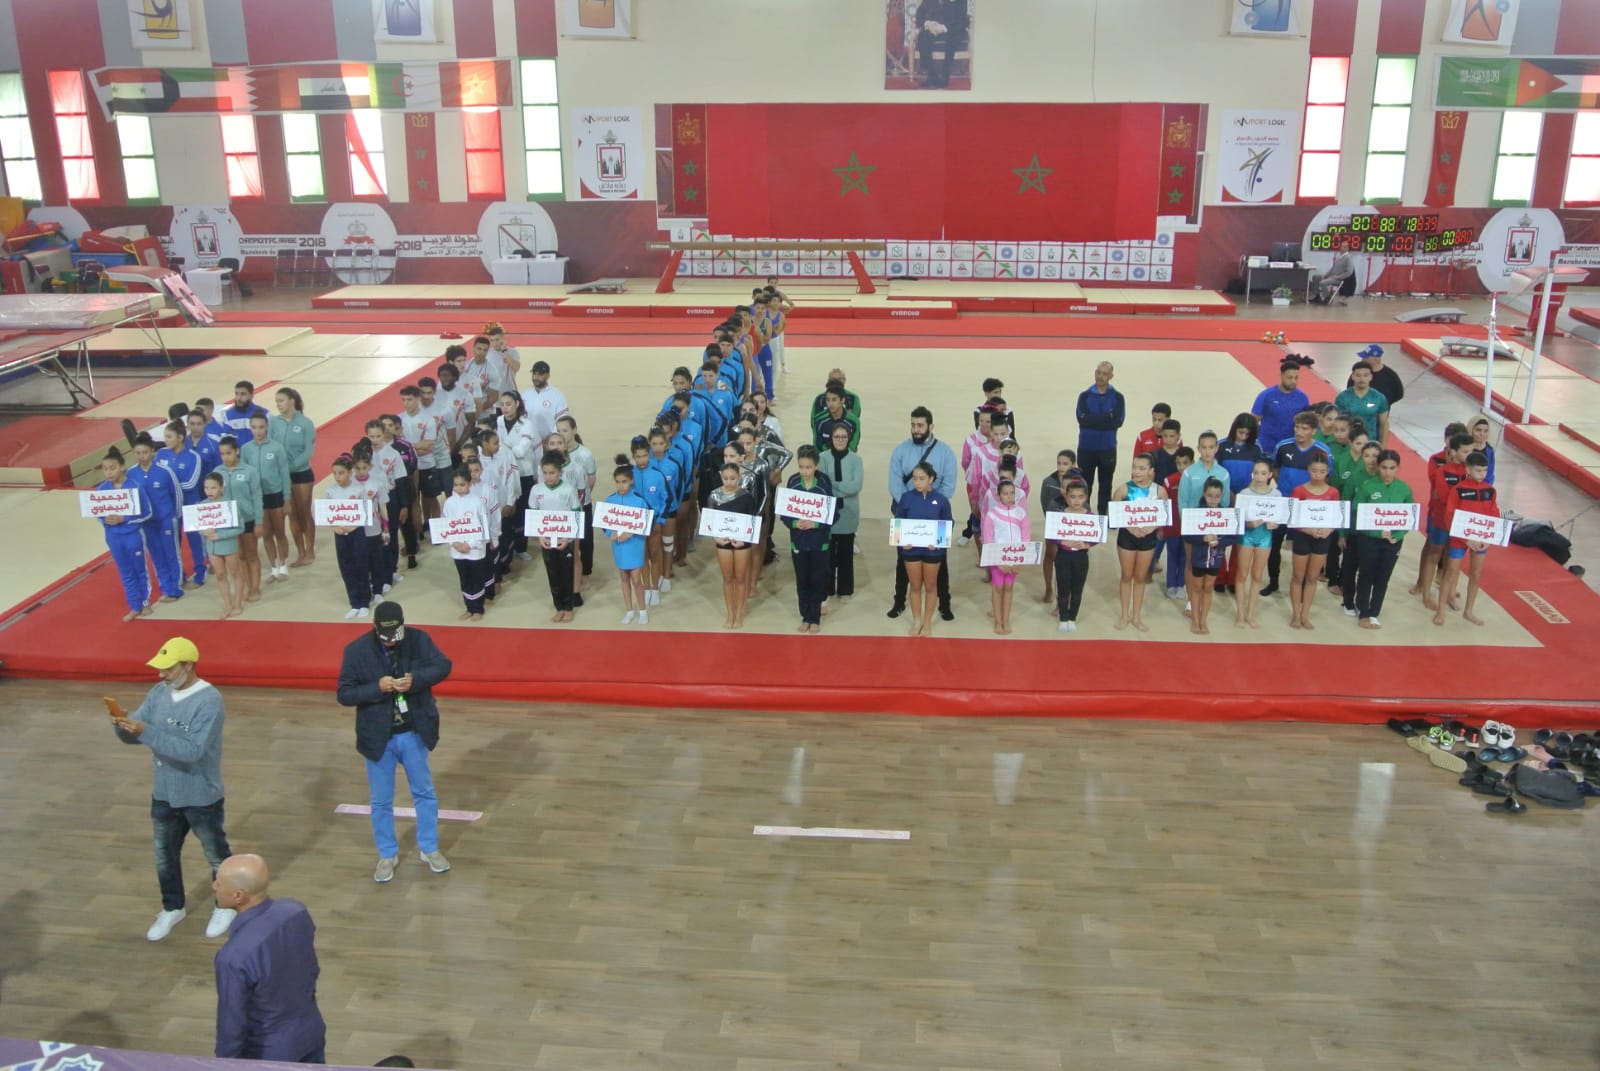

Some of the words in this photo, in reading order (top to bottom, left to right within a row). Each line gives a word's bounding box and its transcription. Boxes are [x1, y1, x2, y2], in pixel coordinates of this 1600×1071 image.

[299, 237, 326, 247] 2018
[394, 240, 422, 251] 2018
[89, 492, 128, 502] الجمعية
[789, 495, 825, 508] أولمبيك
[91, 503, 129, 515] البيضاوي
[329, 503, 359, 512] المغرب
[608, 506, 643, 518] أولمبيك
[787, 504, 822, 518] خريبكة
[1124, 505, 1159, 513] جمعية
[1374, 507, 1408, 516] جمعية
[327, 514, 361, 524] الرباطي
[1205, 510, 1222, 518] وداد
[449, 517, 471, 528] النادي
[542, 515, 568, 524] الدفاع
[602, 515, 644, 529] اليوسفية
[1061, 516, 1095, 527] جمعية
[1128, 516, 1157, 526] النخيل
[537, 525, 571, 535] الفاسي
[1198, 519, 1229, 531] آسفي
[441, 527, 482, 538] المكناسي
[1057, 529, 1098, 538] المحاميد
[1464, 528, 1495, 539] الوجدي
[1002, 555, 1025, 563] وجدة
